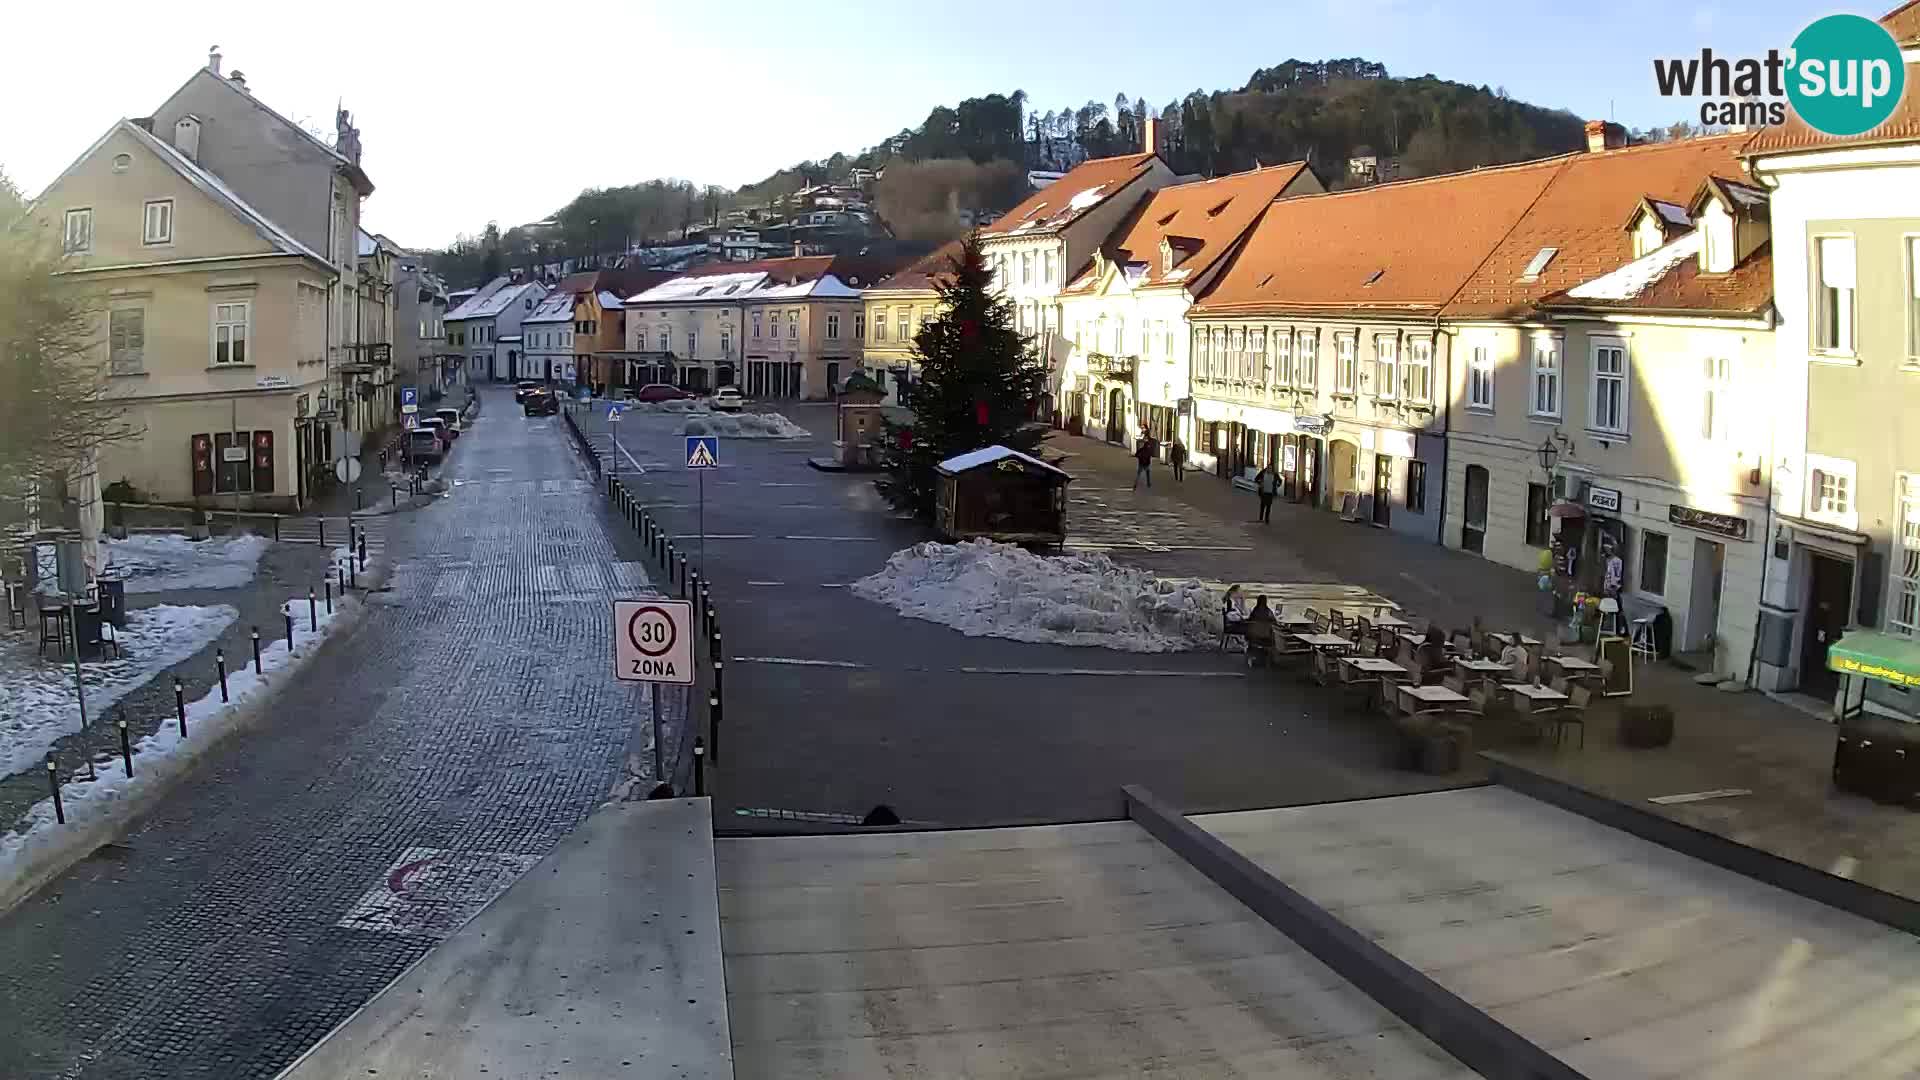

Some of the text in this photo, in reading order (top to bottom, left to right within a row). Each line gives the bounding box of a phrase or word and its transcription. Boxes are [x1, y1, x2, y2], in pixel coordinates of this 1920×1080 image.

[405, 391, 414, 402] P
[641, 622, 665, 643] 30
[631, 659, 676, 677] ZONA
